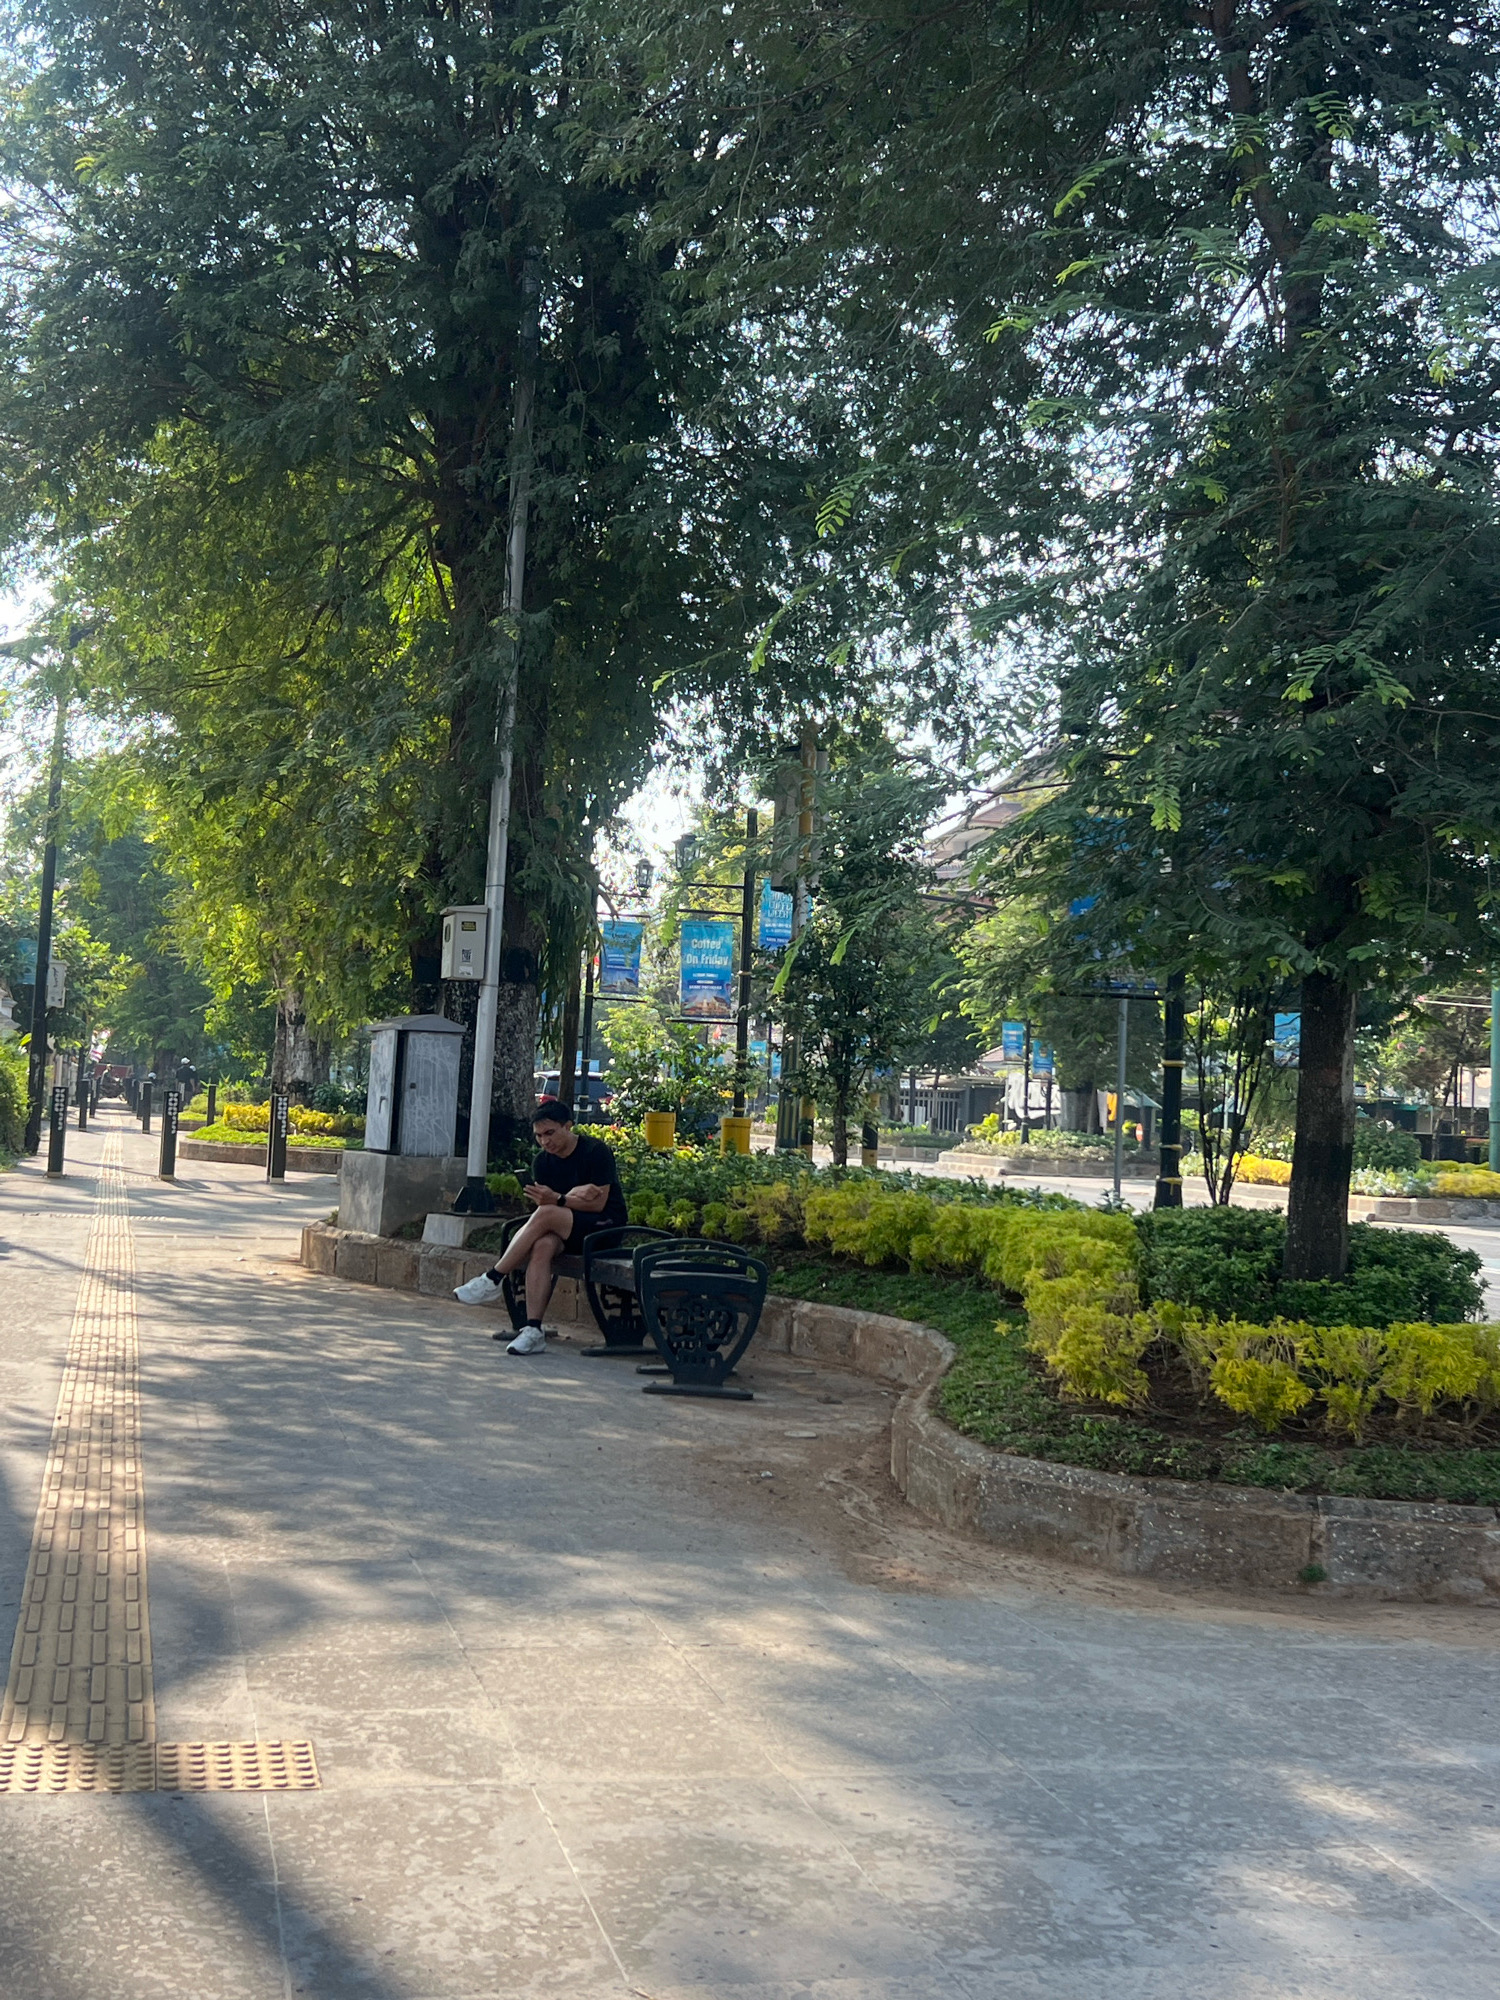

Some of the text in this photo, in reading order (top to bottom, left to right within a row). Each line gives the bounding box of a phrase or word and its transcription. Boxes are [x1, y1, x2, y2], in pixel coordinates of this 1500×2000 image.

[691, 938, 722, 949] Coffee
[686, 953, 728, 966] On Friday
